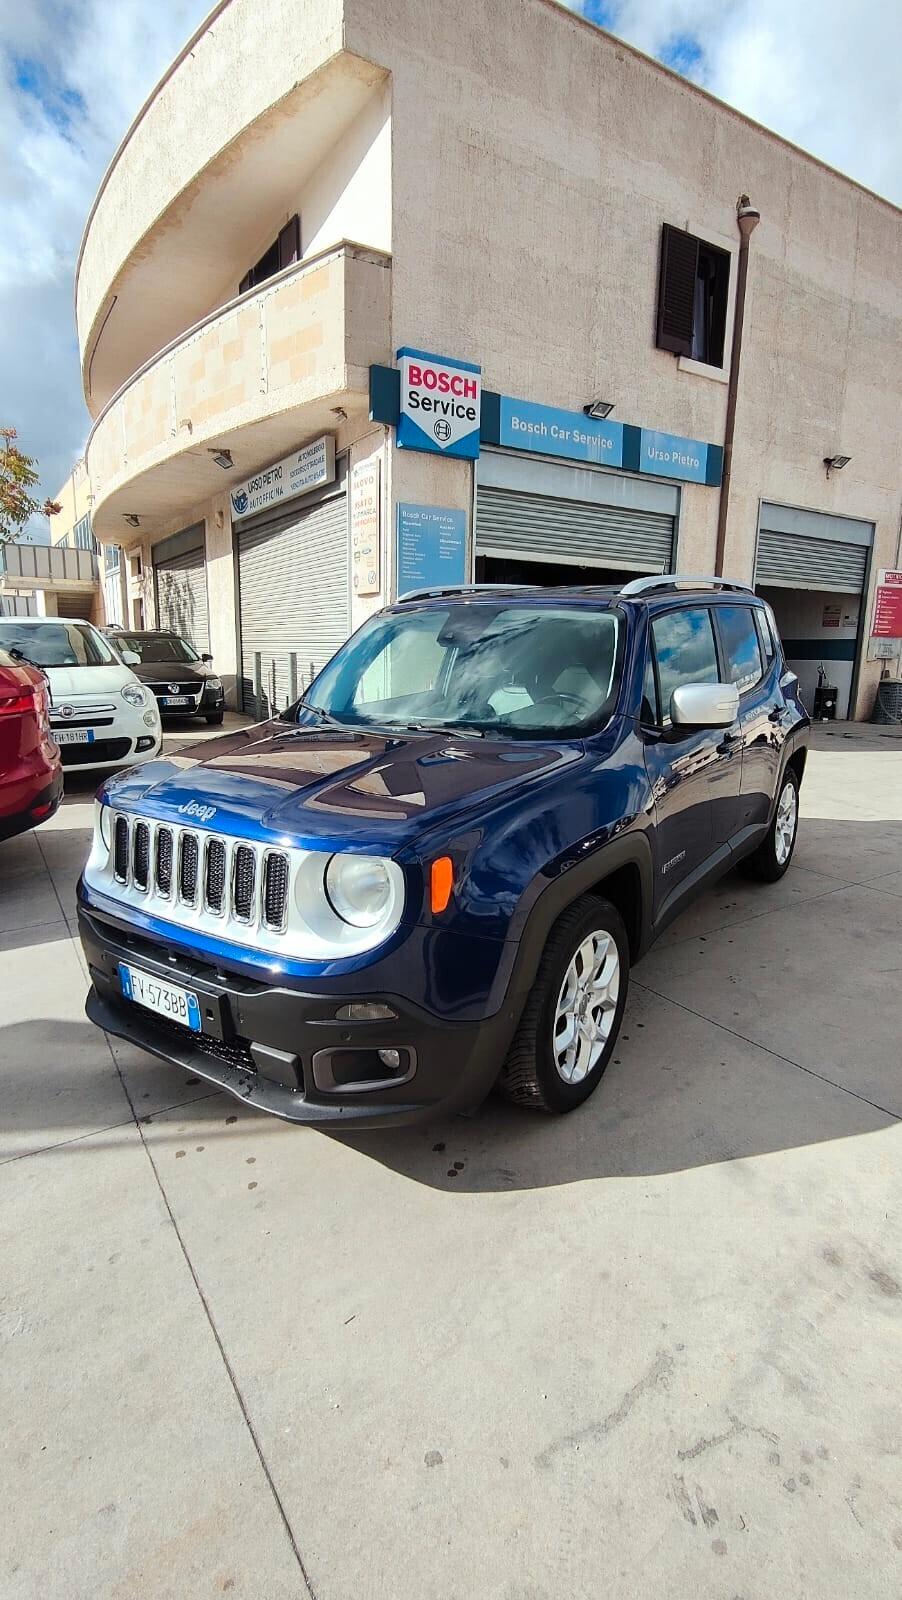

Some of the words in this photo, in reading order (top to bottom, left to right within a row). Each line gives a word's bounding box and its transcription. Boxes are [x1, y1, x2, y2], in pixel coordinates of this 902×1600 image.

[408, 364, 477, 400] BOSCH
[407, 390, 477, 421] Service
[511, 416, 548, 437] Bosch
[551, 424, 571, 441] Car
[572, 429, 614, 449] Service
[648, 447, 670, 462] Urso
[671, 450, 700, 468] Pietro
[247, 476, 262, 494] URSO
[262, 465, 283, 487] PIETRO
[250, 485, 284, 510] AUTOFFICINA
[402, 510, 420, 519] Bosch
[421, 513, 432, 521] Car
[432, 514, 454, 523] Service
[178, 800, 217, 822] Jeep
[148, 983, 187, 1017] 573BB
